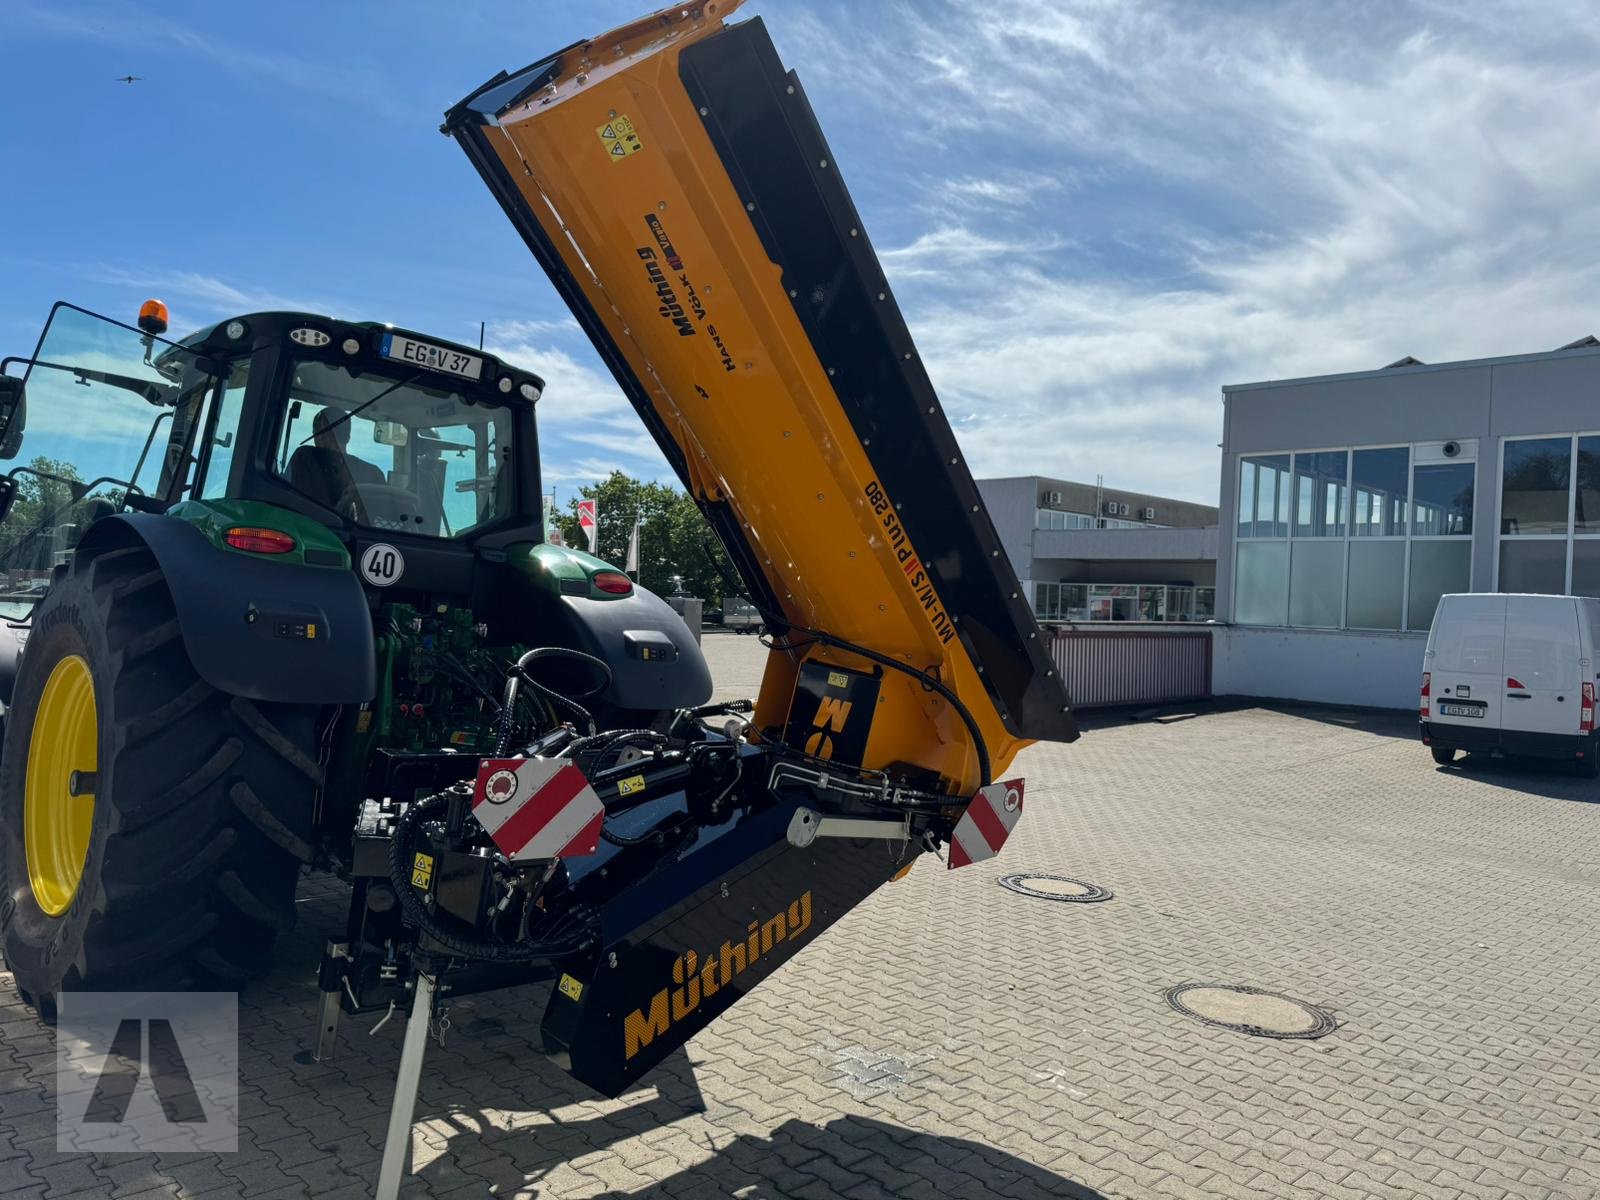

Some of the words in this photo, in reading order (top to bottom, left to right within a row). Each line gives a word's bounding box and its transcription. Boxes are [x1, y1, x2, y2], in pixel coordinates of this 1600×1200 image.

[651, 220, 670, 249] Vario
[636, 246, 696, 337] Müthing
[678, 273, 706, 321] VÖLK
[449, 354, 471, 373] 37
[706, 324, 736, 372] HANS
[864, 481, 889, 516] 280
[883, 513, 912, 564] Plus
[368, 550, 396, 579] 40
[911, 570, 955, 646] MU-M/S
[624, 889, 812, 1060] Müthing
